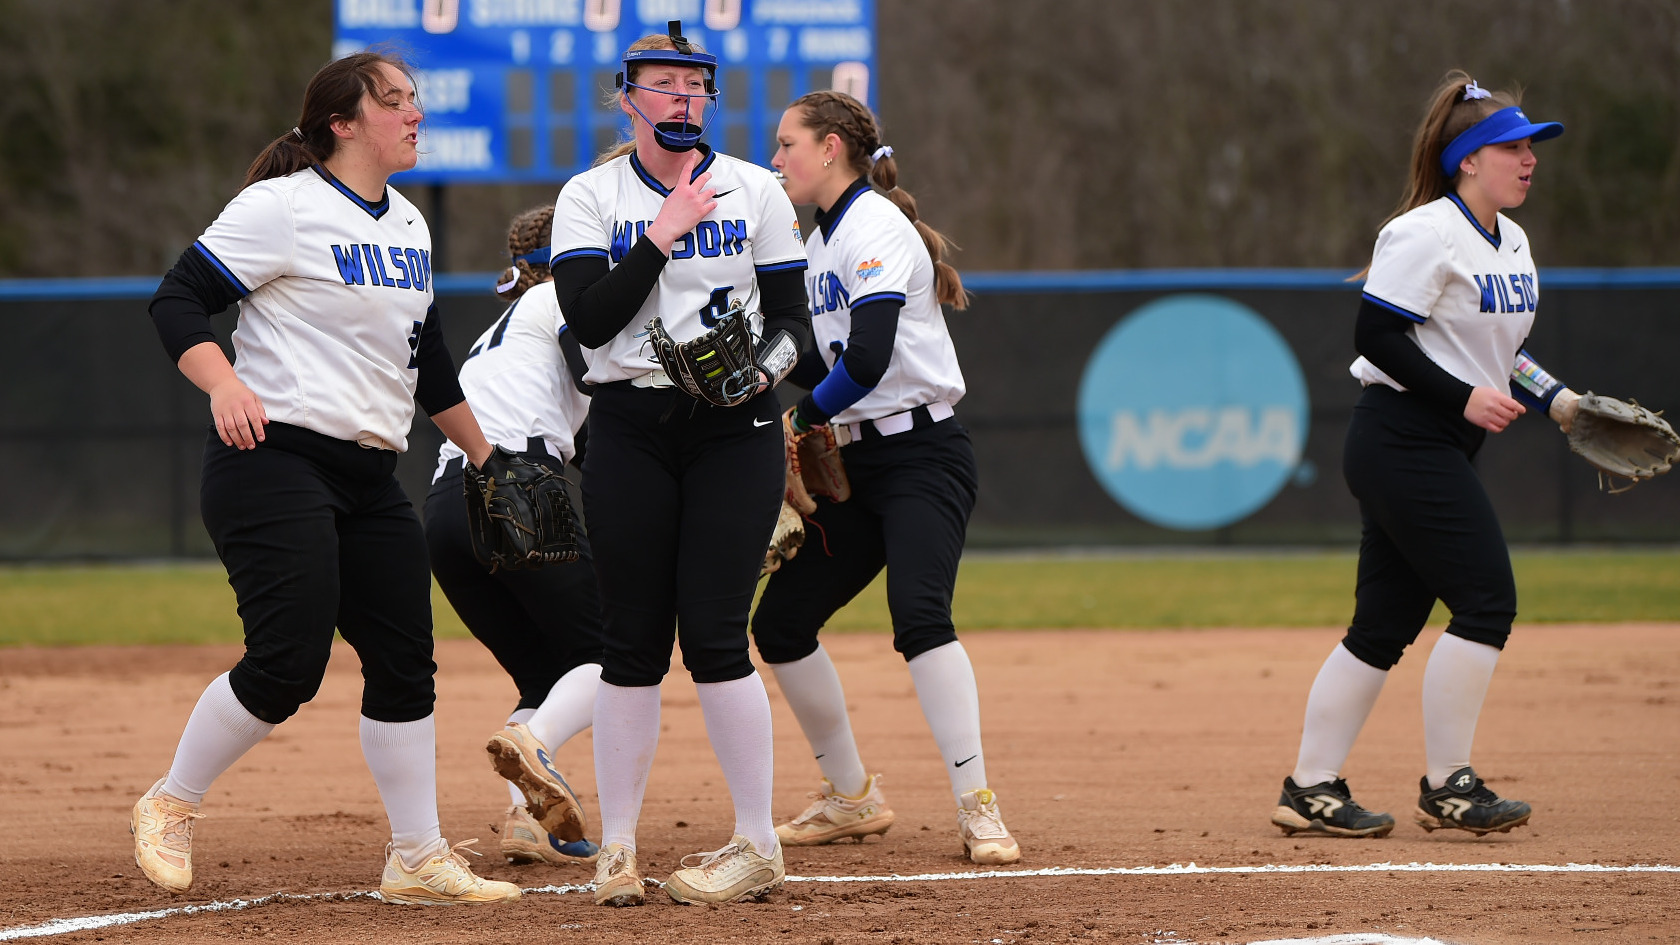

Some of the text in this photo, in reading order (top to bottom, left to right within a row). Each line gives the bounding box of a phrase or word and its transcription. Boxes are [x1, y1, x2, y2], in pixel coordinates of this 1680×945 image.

[610, 219, 748, 263] WSON
[1473, 272, 1538, 313] WILSO
[1107, 404, 1299, 472] NCAA
